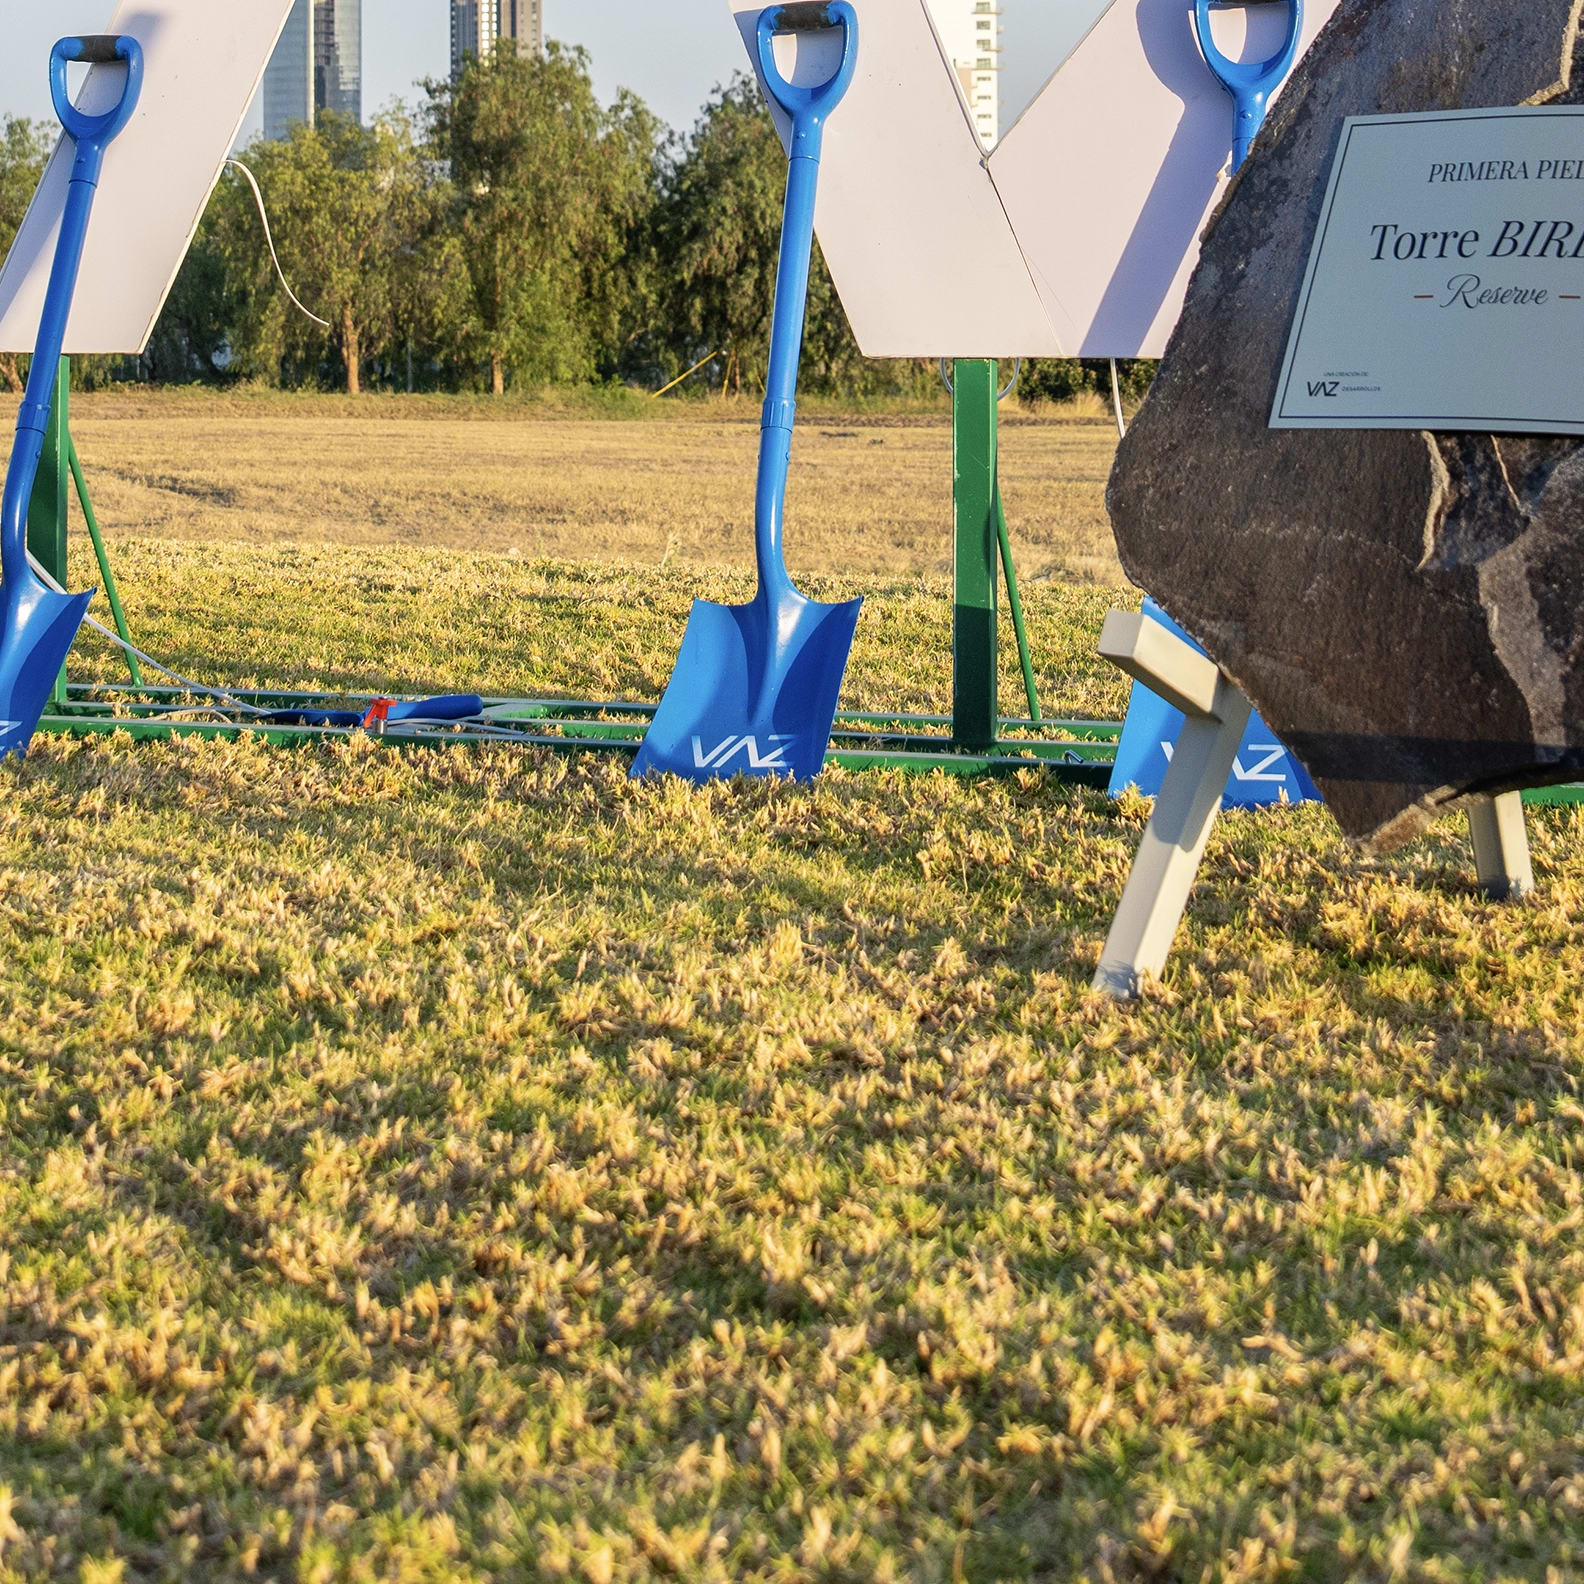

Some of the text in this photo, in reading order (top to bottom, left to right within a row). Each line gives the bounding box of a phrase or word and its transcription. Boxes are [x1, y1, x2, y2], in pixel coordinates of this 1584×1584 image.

[1427, 160, 1529, 184] PRIMERA
[1370, 224, 1480, 261] Torre
[1439, 273, 1549, 309] Reserve
[1306, 381, 1341, 397] VAZ
[691, 734, 797, 768] VAZ
